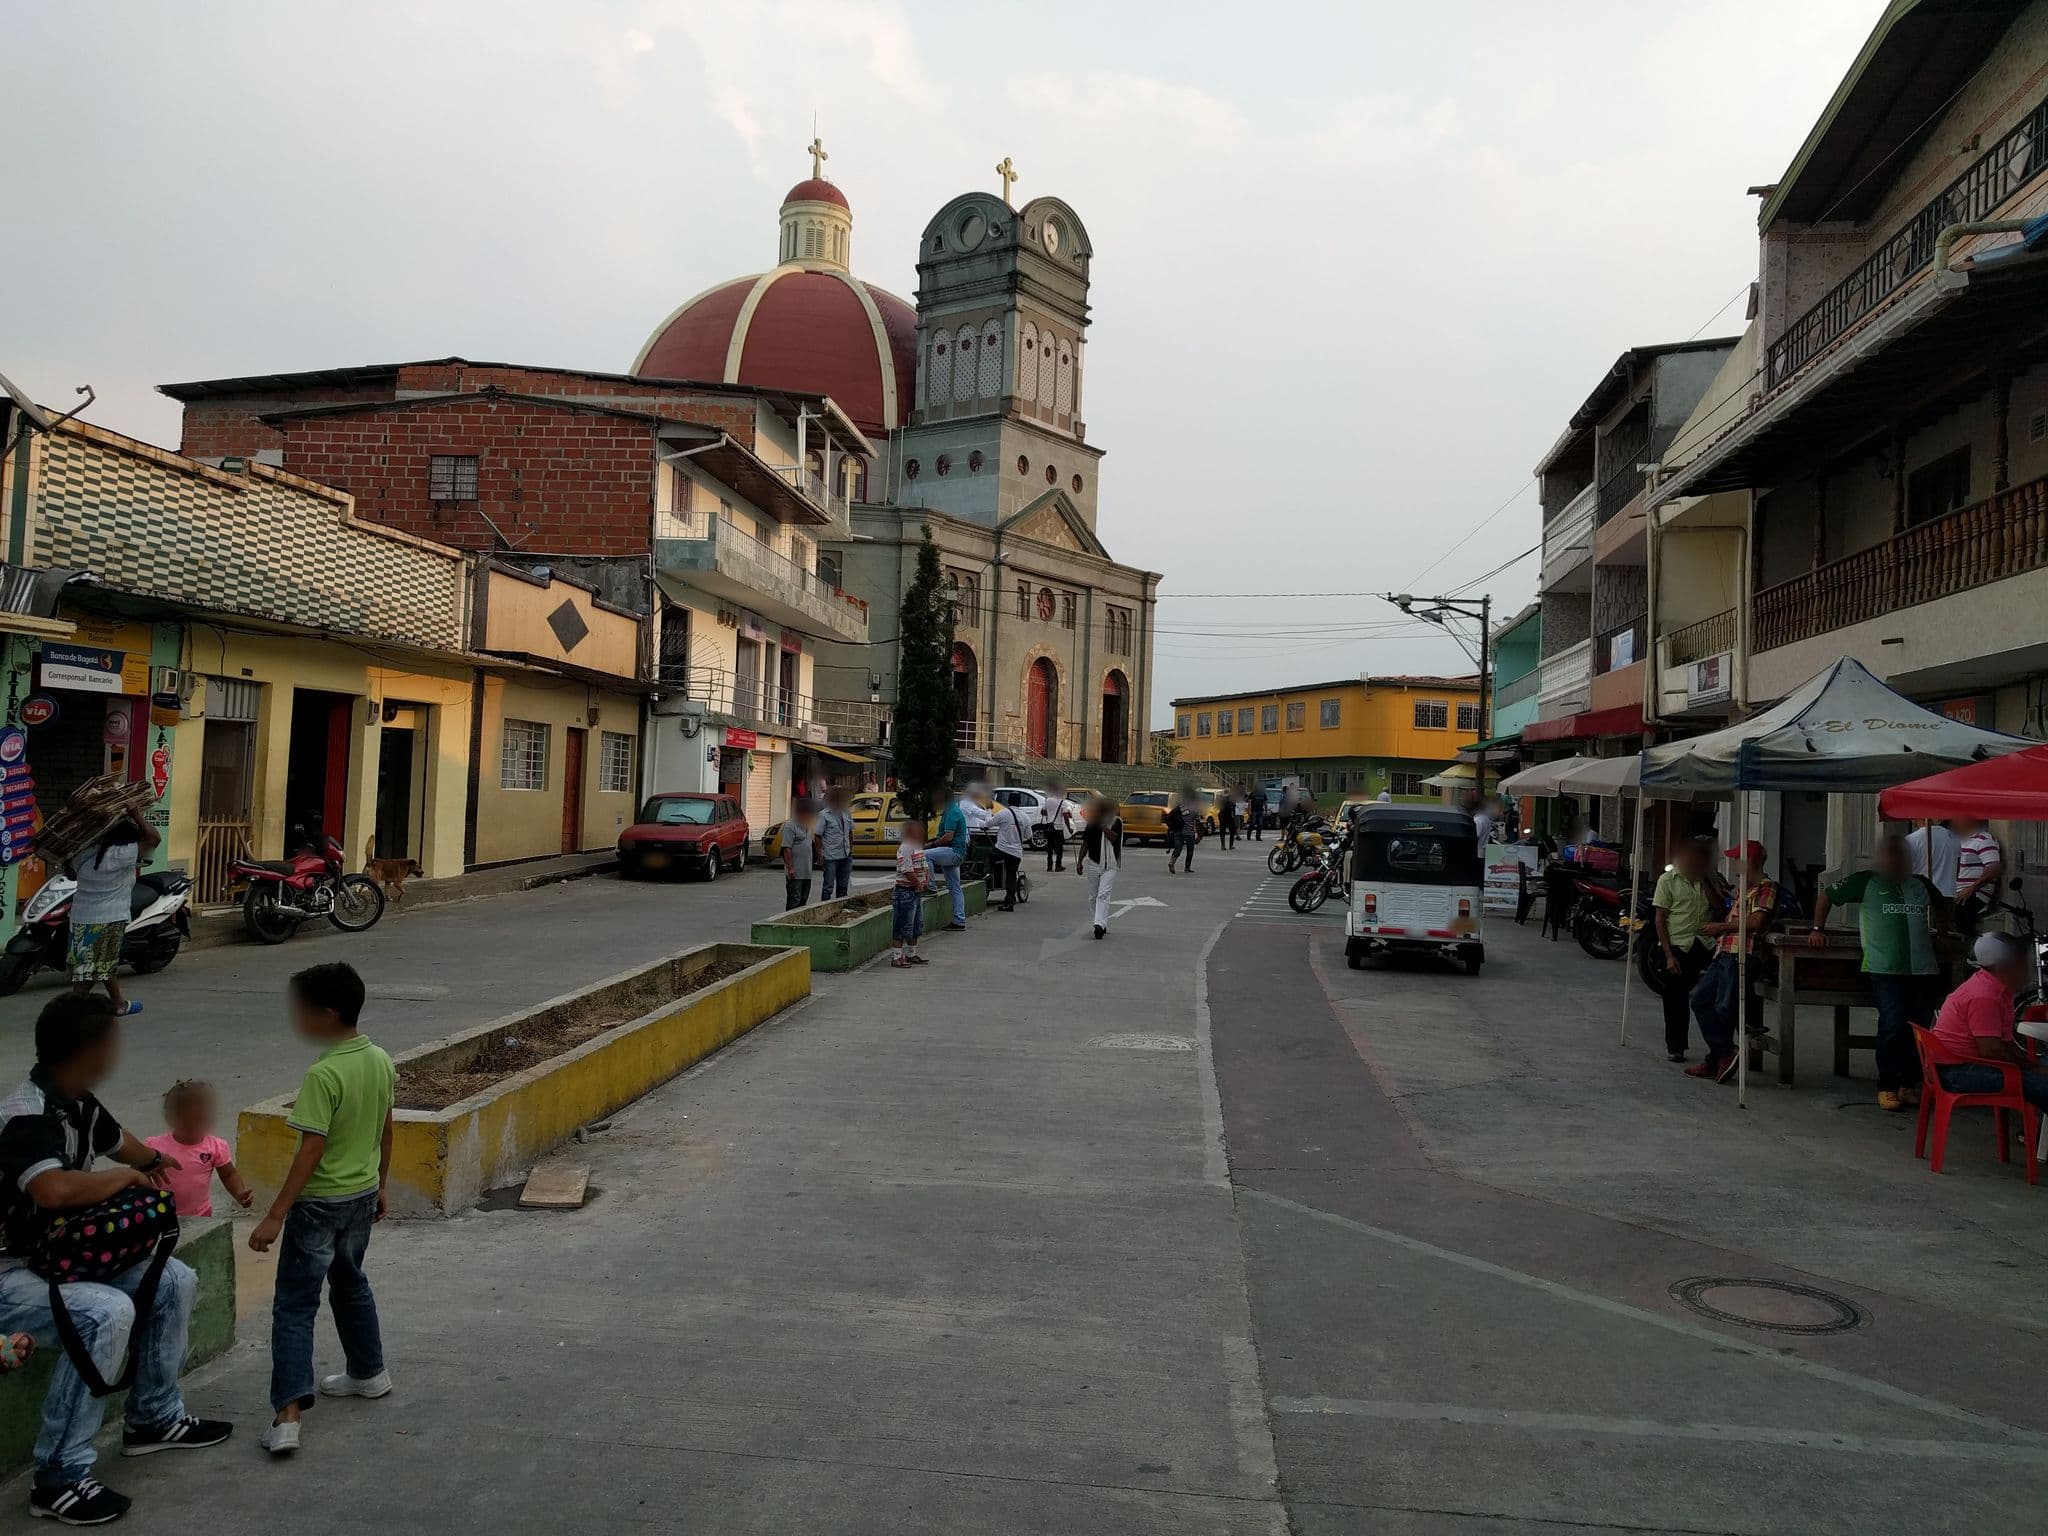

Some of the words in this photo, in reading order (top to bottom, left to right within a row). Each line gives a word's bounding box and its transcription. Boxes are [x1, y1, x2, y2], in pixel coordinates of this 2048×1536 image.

[50, 651, 69, 660] Banco
[70, 653, 77, 662] de
[48, 671, 87, 681] Corresponsal
[89, 675, 113, 684] Bancario
